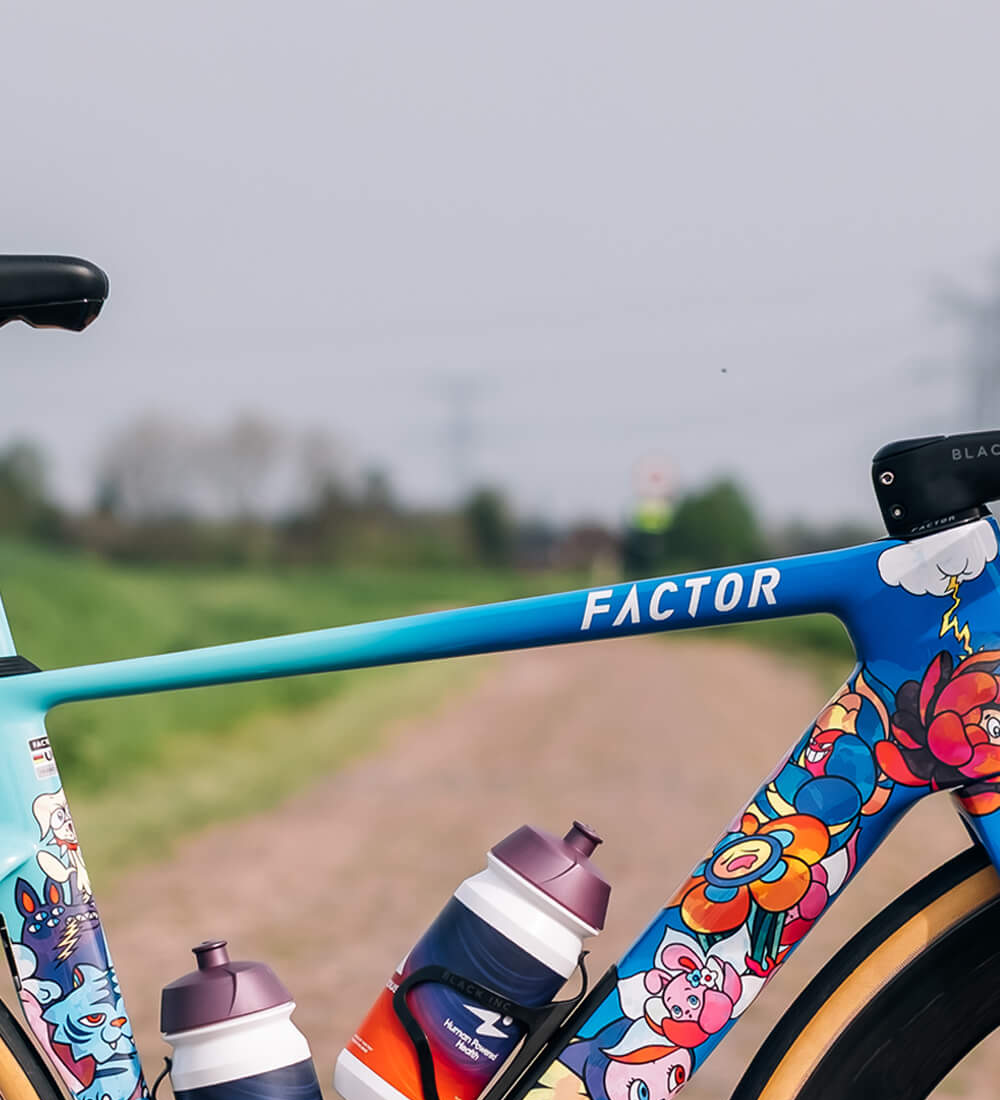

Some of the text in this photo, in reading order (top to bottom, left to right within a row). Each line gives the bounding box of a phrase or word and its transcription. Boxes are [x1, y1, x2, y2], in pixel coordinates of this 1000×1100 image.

[580, 566, 781, 631] FACTOR
[443, 1018, 500, 1062] Human Powered
[455, 1039, 480, 1061] Health
